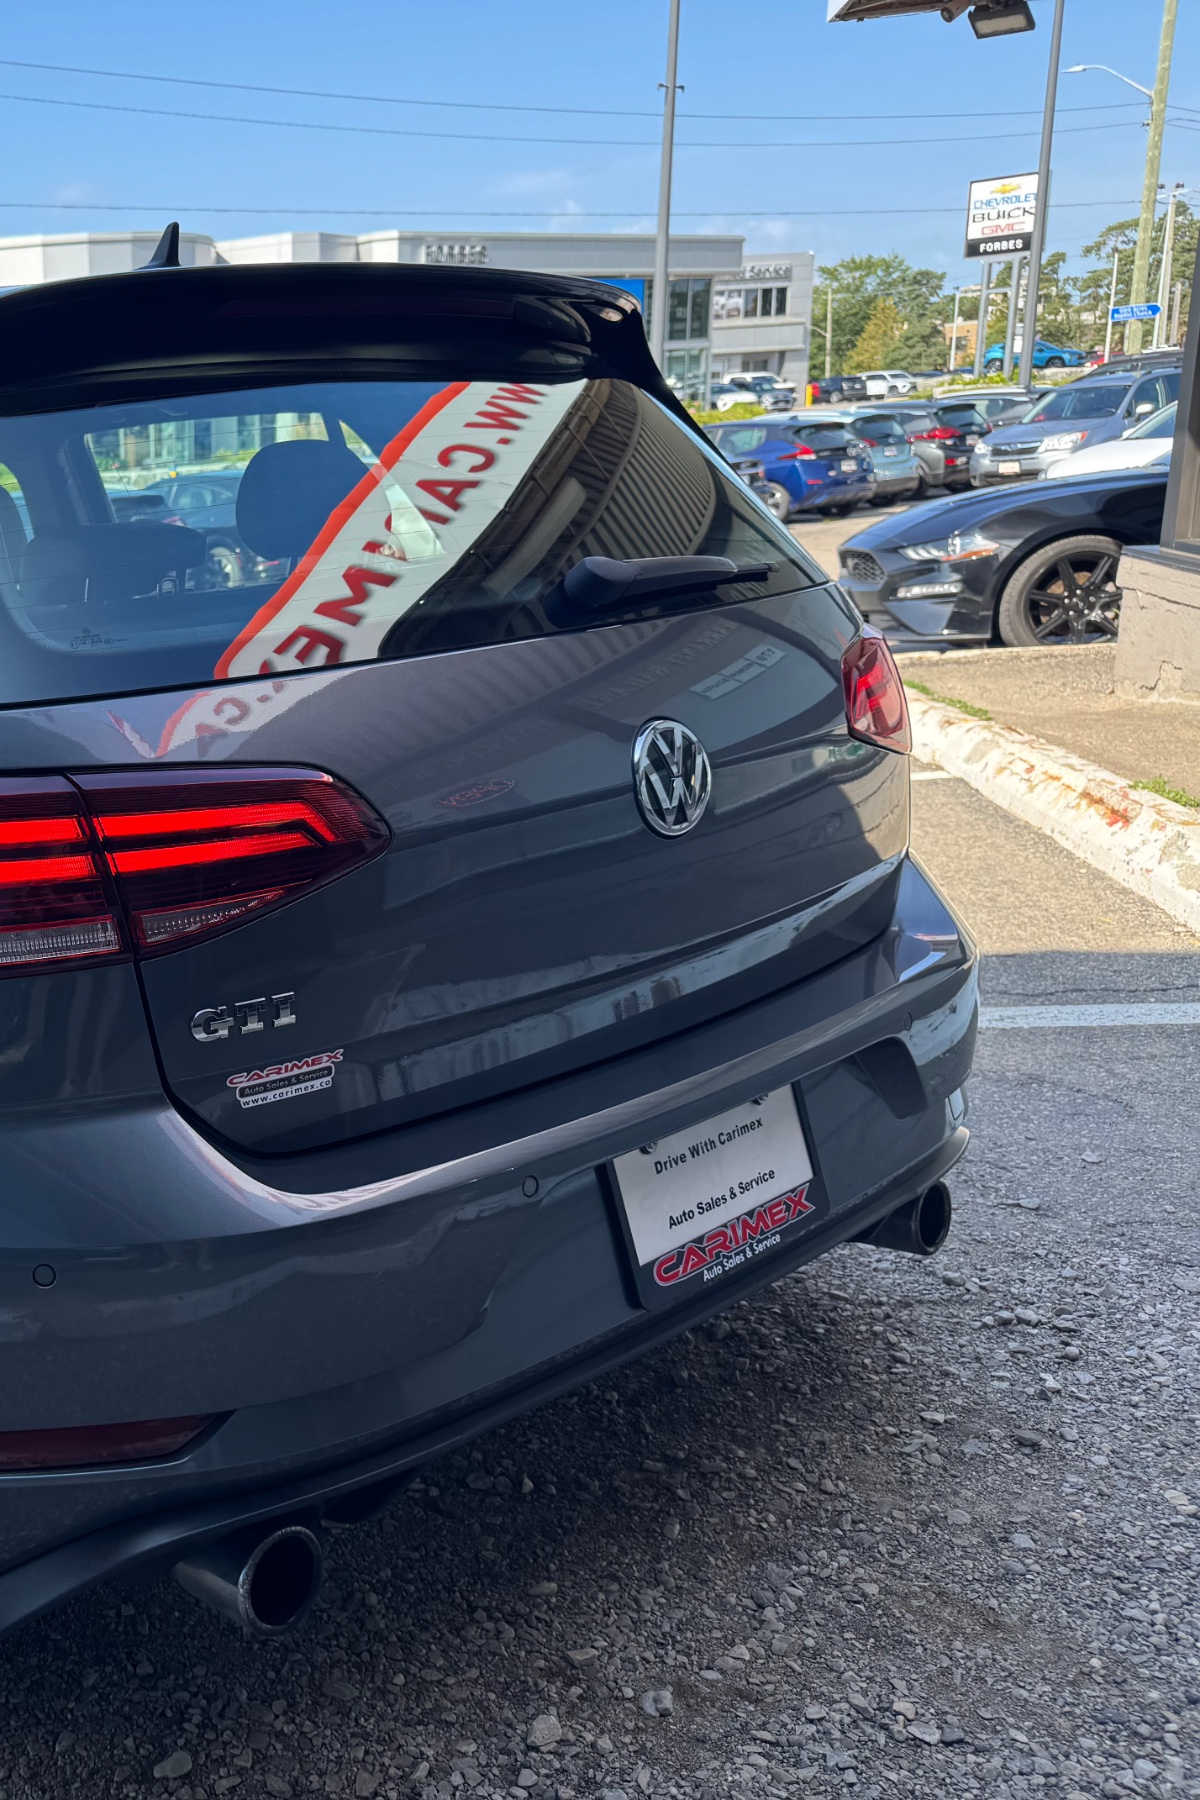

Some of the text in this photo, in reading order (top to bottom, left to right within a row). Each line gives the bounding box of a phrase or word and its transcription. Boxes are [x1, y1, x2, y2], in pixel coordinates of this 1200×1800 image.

[972, 206, 1036, 223] BUICK
[981, 221, 1026, 236] GMC
[979, 238, 1024, 253] FORBES
[190, 991, 297, 1042] GTI
[227, 1049, 344, 1086] CARIMEX
[243, 1069, 329, 1096] Auto Sales & Service
[242, 1079, 331, 1108] www.carimex.ca
[653, 1117, 764, 1175] Drive With Carimex
[668, 1169, 776, 1230] Auto Sales & Service
[654, 1184, 814, 1285] CARIMEX
[703, 1232, 781, 1282] Auto Sales & Service
